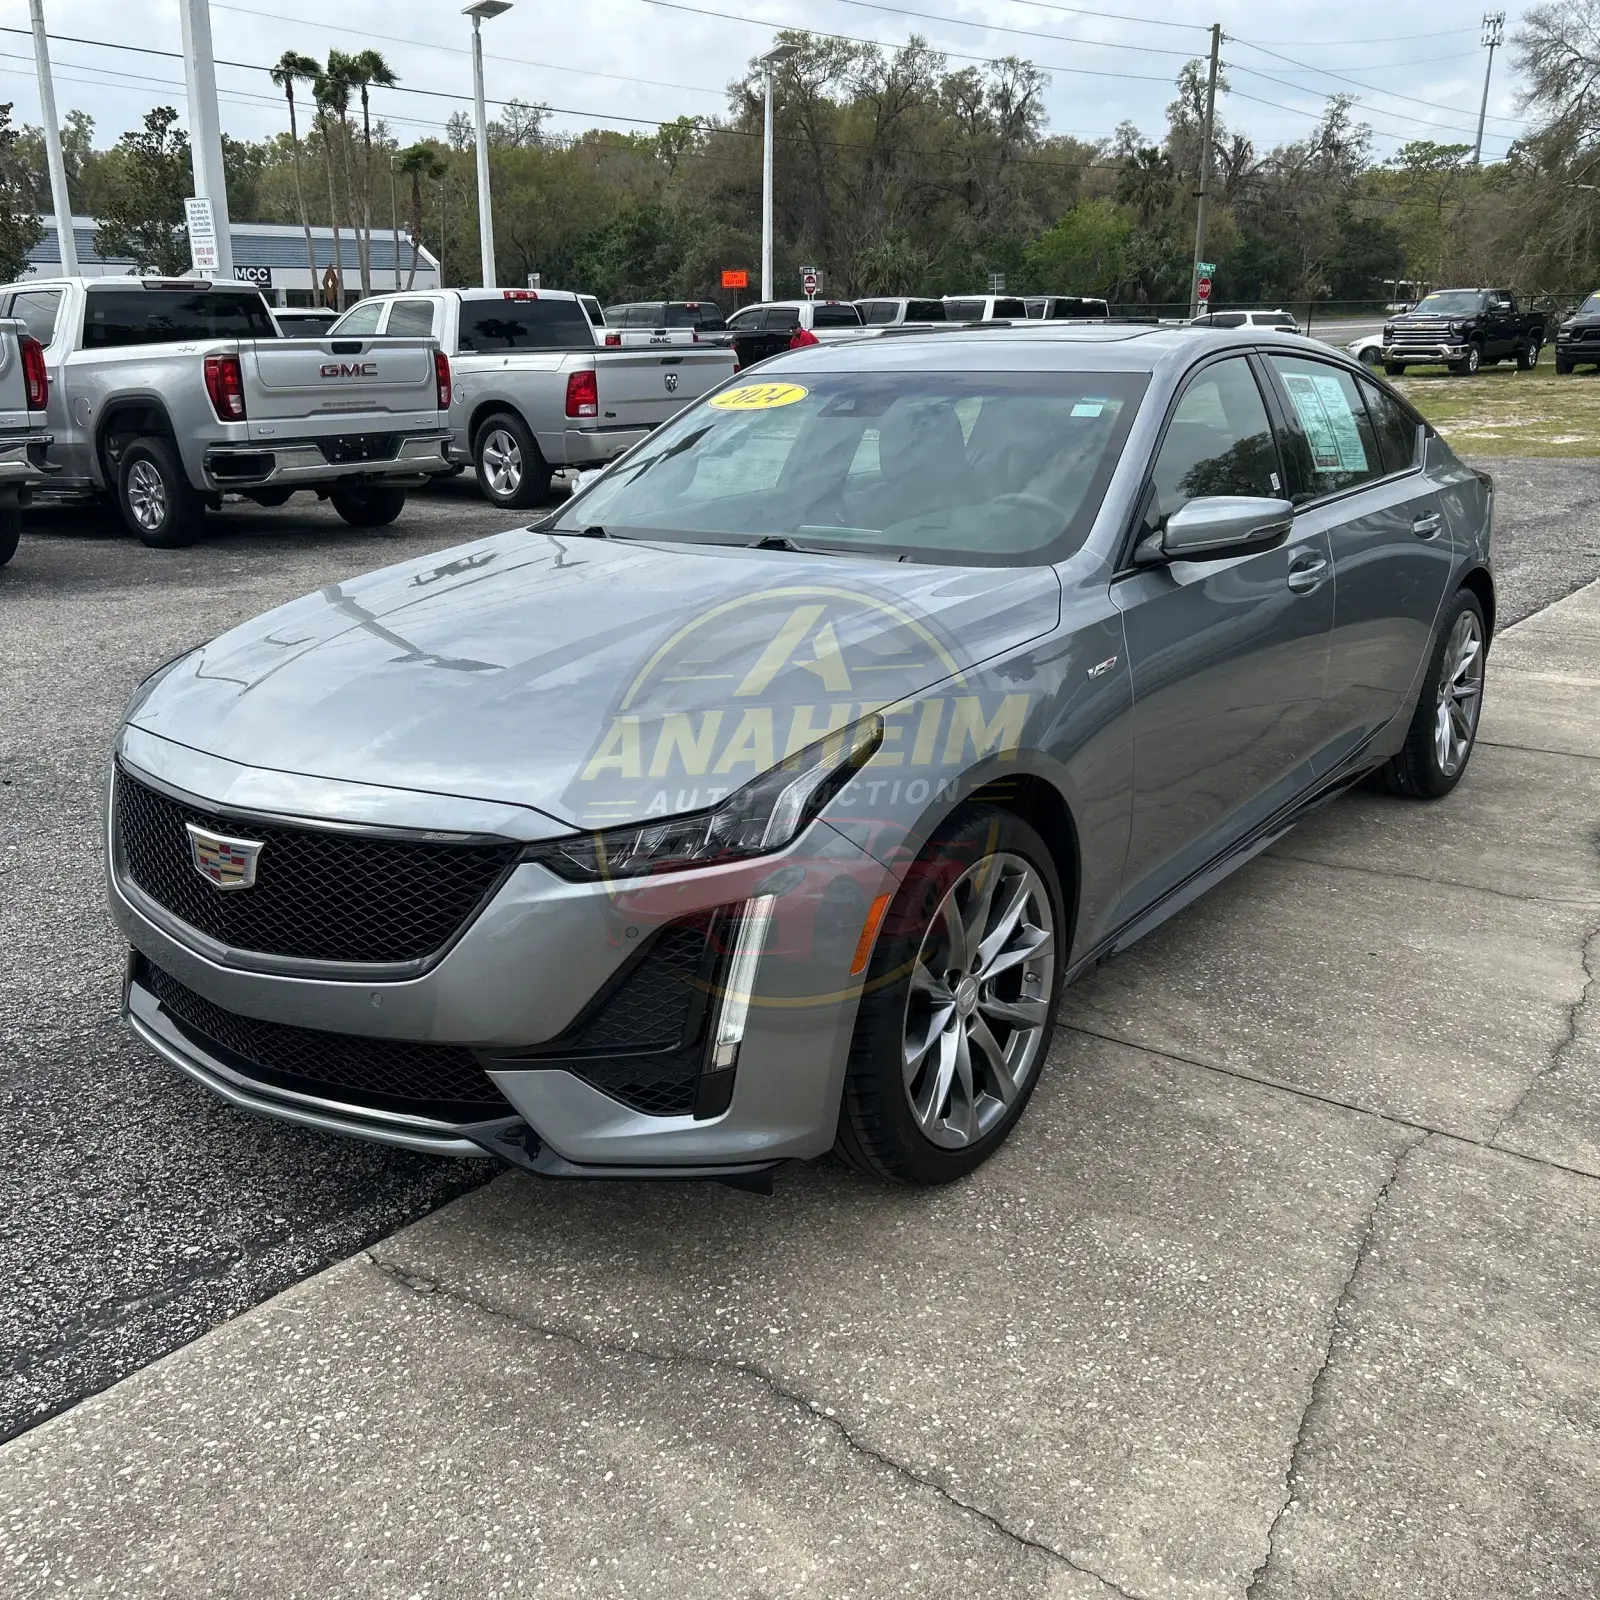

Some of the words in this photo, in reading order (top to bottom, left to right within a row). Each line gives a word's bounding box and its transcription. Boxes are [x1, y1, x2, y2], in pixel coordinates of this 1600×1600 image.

[234, 268, 268, 281] MCC
[1199, 284, 1210, 292] STOP
[319, 363, 378, 378] GMC
[716, 387, 797, 405] 2024
